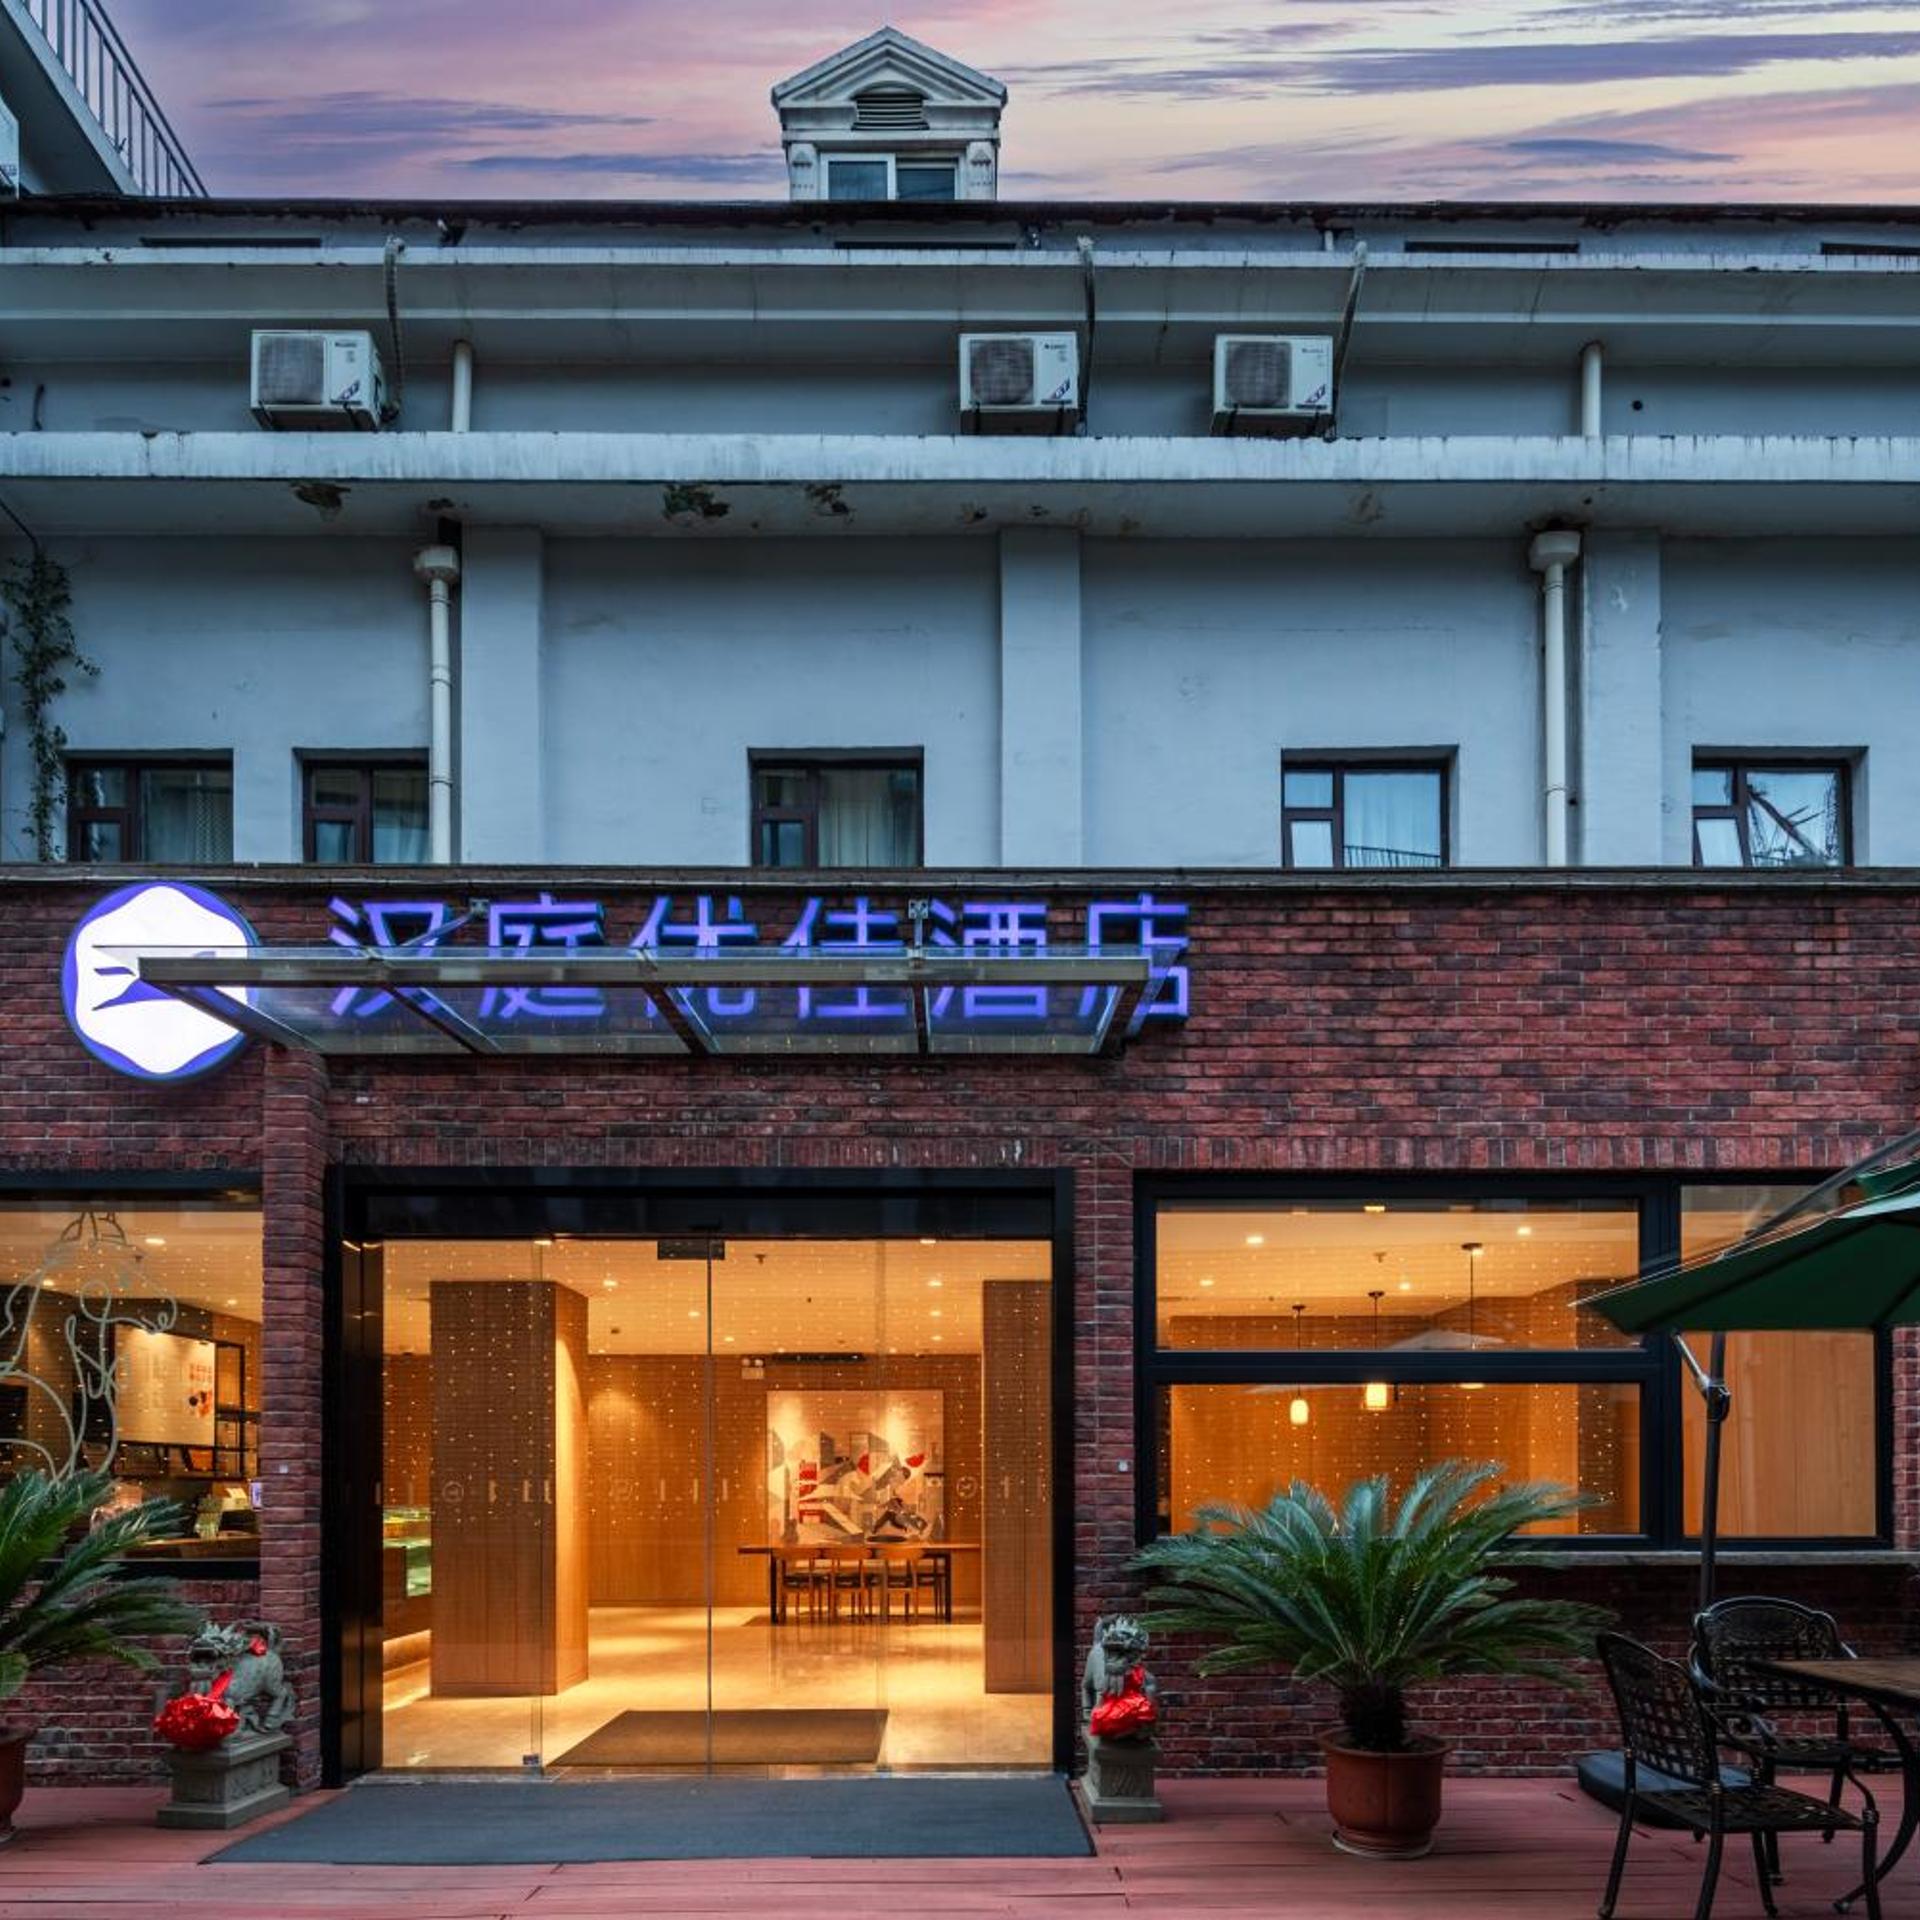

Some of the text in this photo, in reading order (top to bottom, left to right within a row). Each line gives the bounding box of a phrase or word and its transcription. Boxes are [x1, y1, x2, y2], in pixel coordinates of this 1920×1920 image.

[329, 893, 1189, 1019] 汉庭优佳酒店
